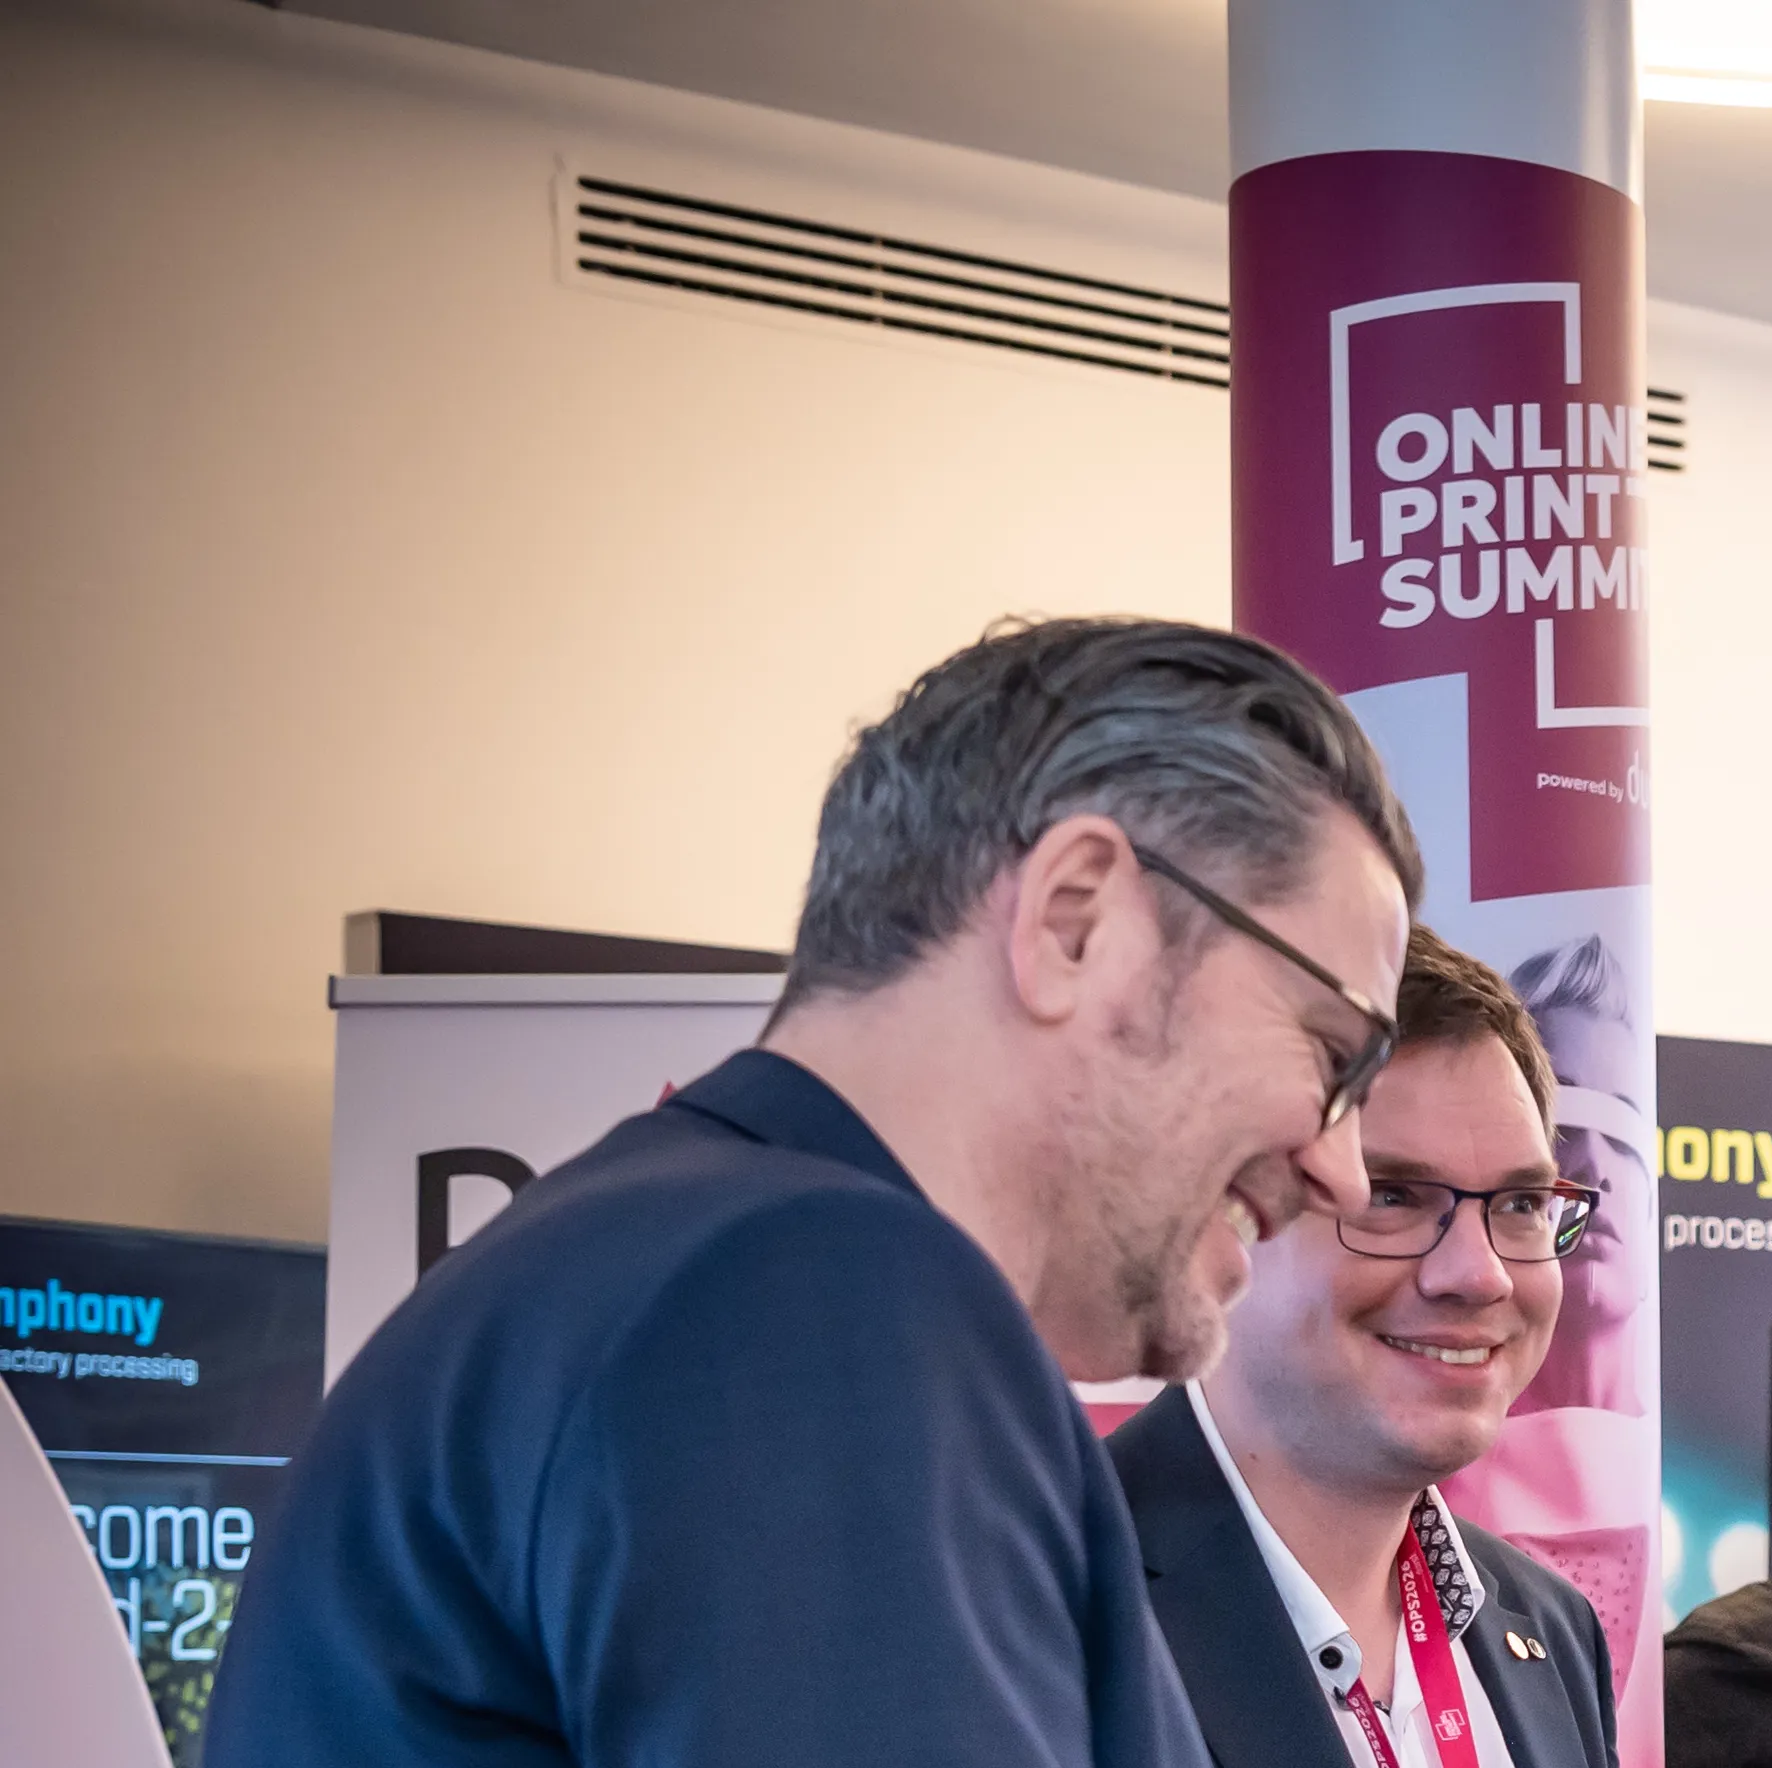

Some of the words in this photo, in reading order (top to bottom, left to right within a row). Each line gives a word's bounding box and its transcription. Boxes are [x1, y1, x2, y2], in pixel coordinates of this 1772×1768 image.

[1376, 402, 1647, 481] ONLINE
[1381, 474, 1620, 556] PRINT
[1536, 772, 1607, 796] powered
[1608, 781, 1624, 803] by
[75, 1352, 199, 1387] processing
